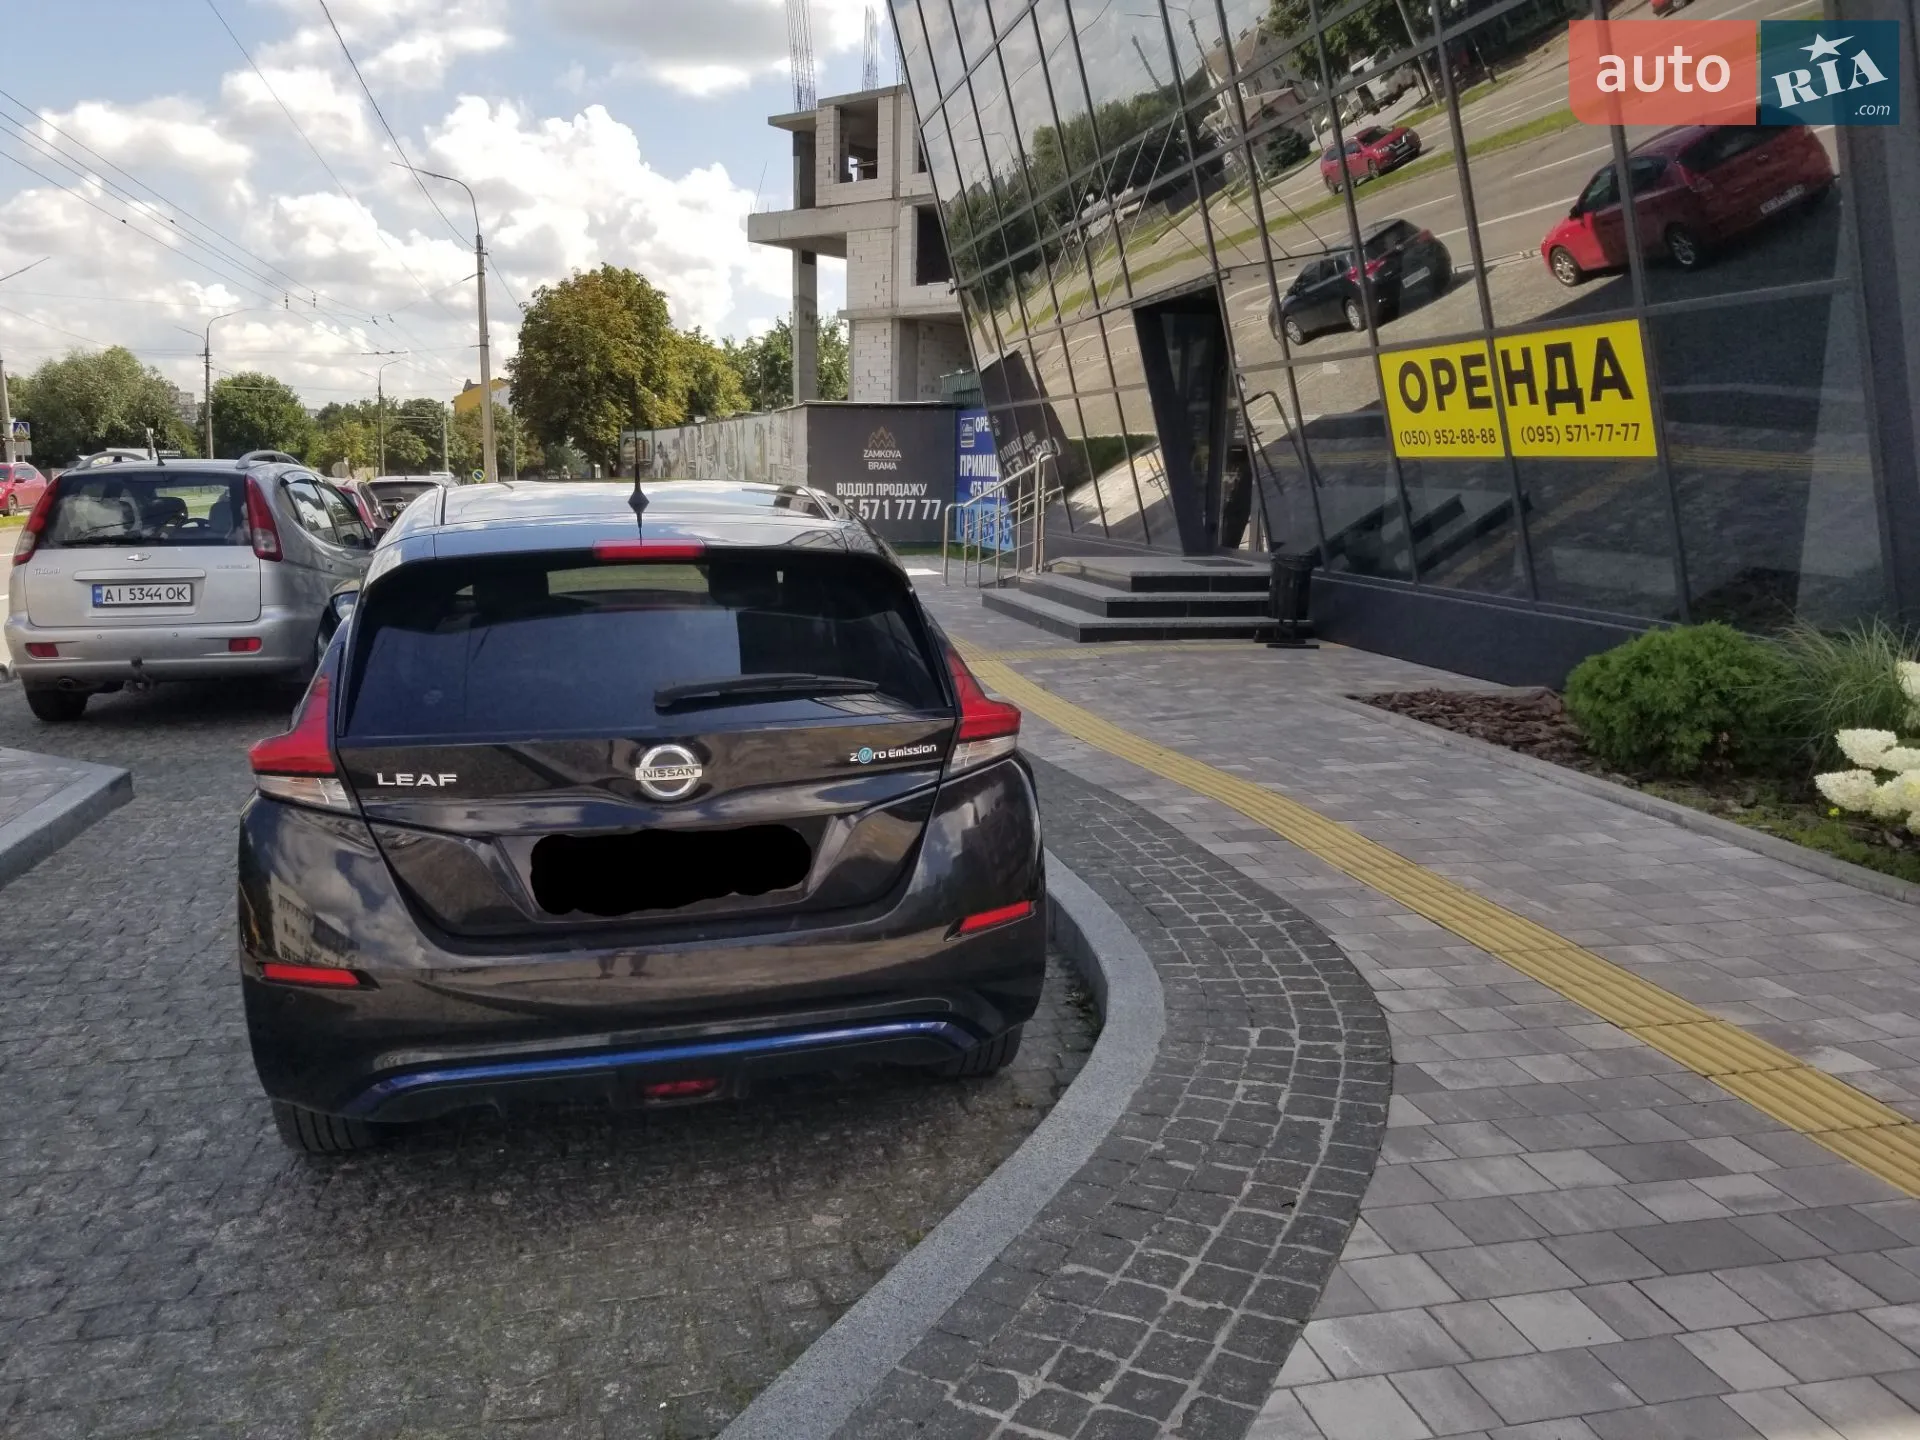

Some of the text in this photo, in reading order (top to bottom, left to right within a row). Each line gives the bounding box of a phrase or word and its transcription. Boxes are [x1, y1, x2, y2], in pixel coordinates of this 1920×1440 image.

[1398, 337, 1634, 416] ОРЕНДА
[975, 416, 991, 433] ОРЕ
[1400, 428, 1496, 447] (050) 952-88-88
[1521, 423, 1640, 446] (095) 571-77-77
[863, 449, 902, 458] ZAMKOVA
[868, 461, 897, 470] BRAMA
[960, 454, 1001, 481] ПРИМІЩ
[836, 482, 927, 497] ВІДДІЛ ПРОДАЖУ
[859, 499, 890, 520] 571
[895, 499, 916, 520] 77
[920, 499, 941, 520] 77
[105, 586, 187, 602] AI 5344 OK
[888, 744, 937, 758] Emission
[377, 772, 458, 787] LEAF
[643, 767, 696, 778] NISSAN
